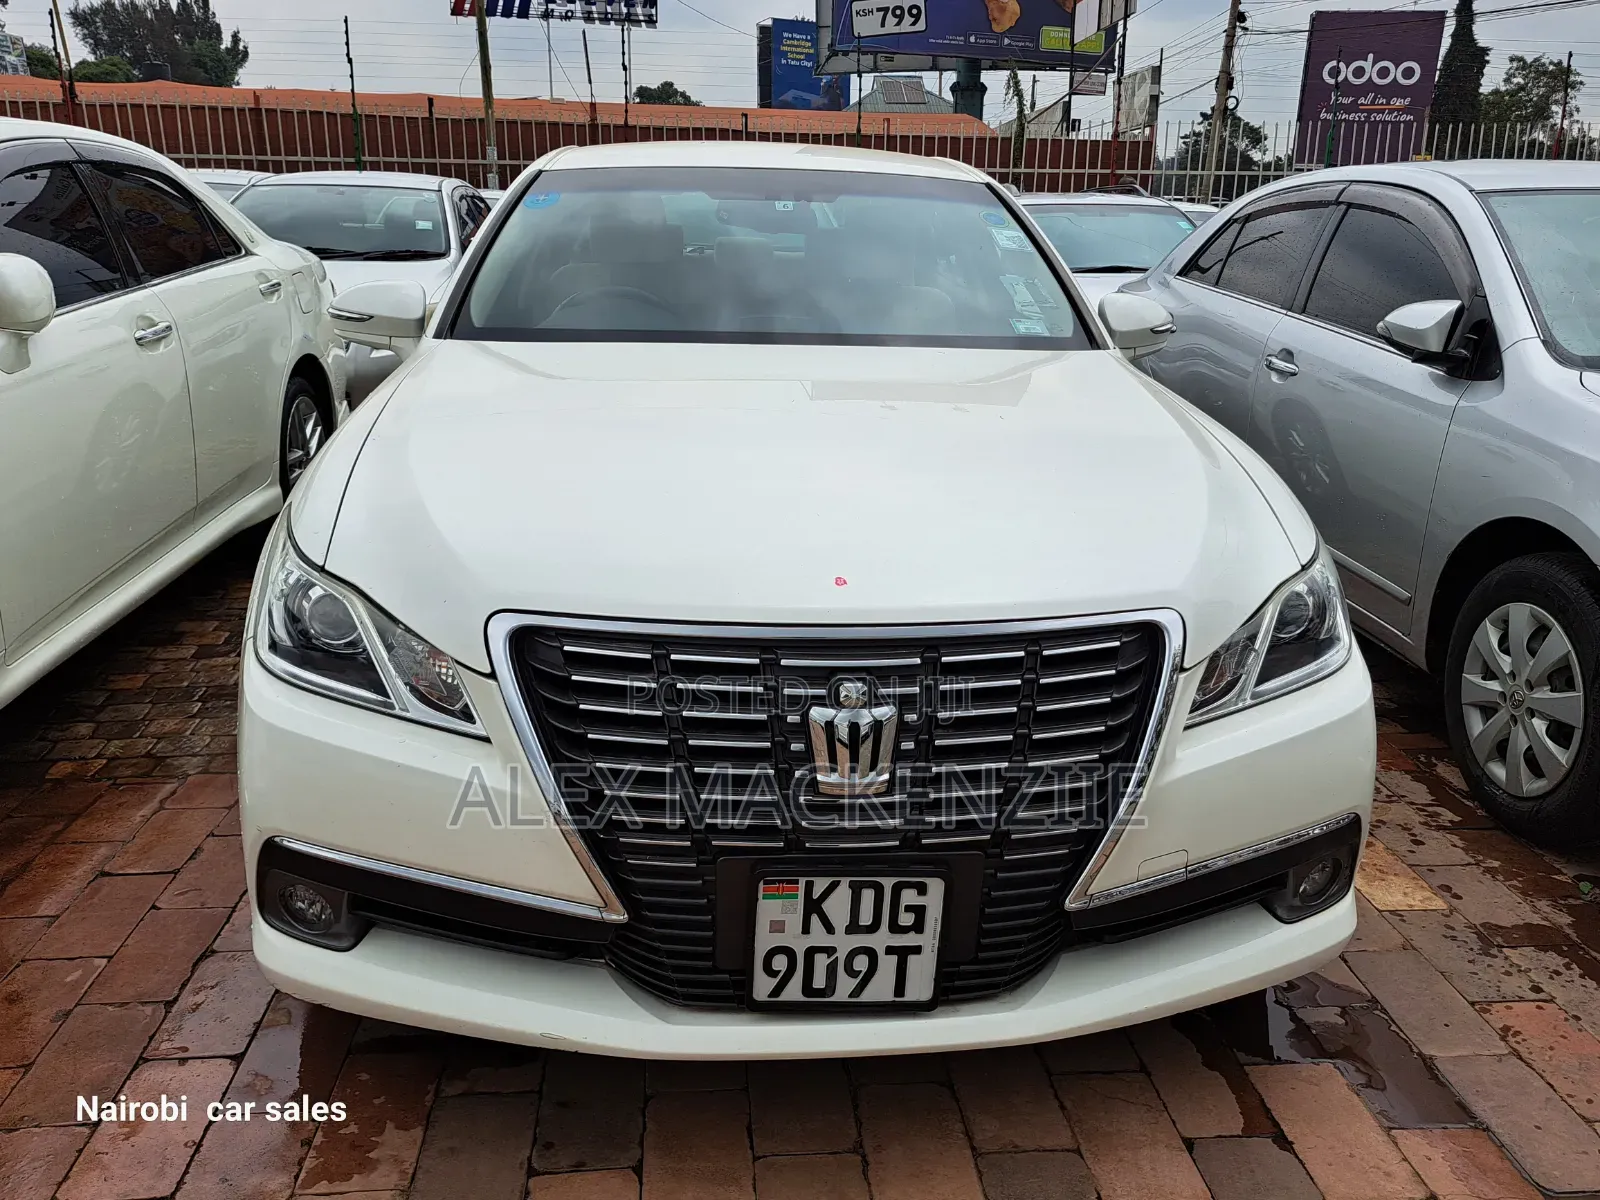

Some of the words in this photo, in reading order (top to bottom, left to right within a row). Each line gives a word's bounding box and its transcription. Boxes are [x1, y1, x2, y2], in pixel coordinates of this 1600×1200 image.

[855, 8, 874, 17] KSH
[876, 4, 922, 28] 799
[781, 45, 814, 53] International
[783, 39, 811, 47] Cambridge
[1322, 53, 1421, 86] odoo
[1358, 93, 1375, 105] all
[1375, 95, 1386, 105] in
[1390, 97, 1411, 106] one
[1370, 109, 1414, 121] solution
[801, 879, 928, 935] KDG
[762, 944, 923, 999] 909T
